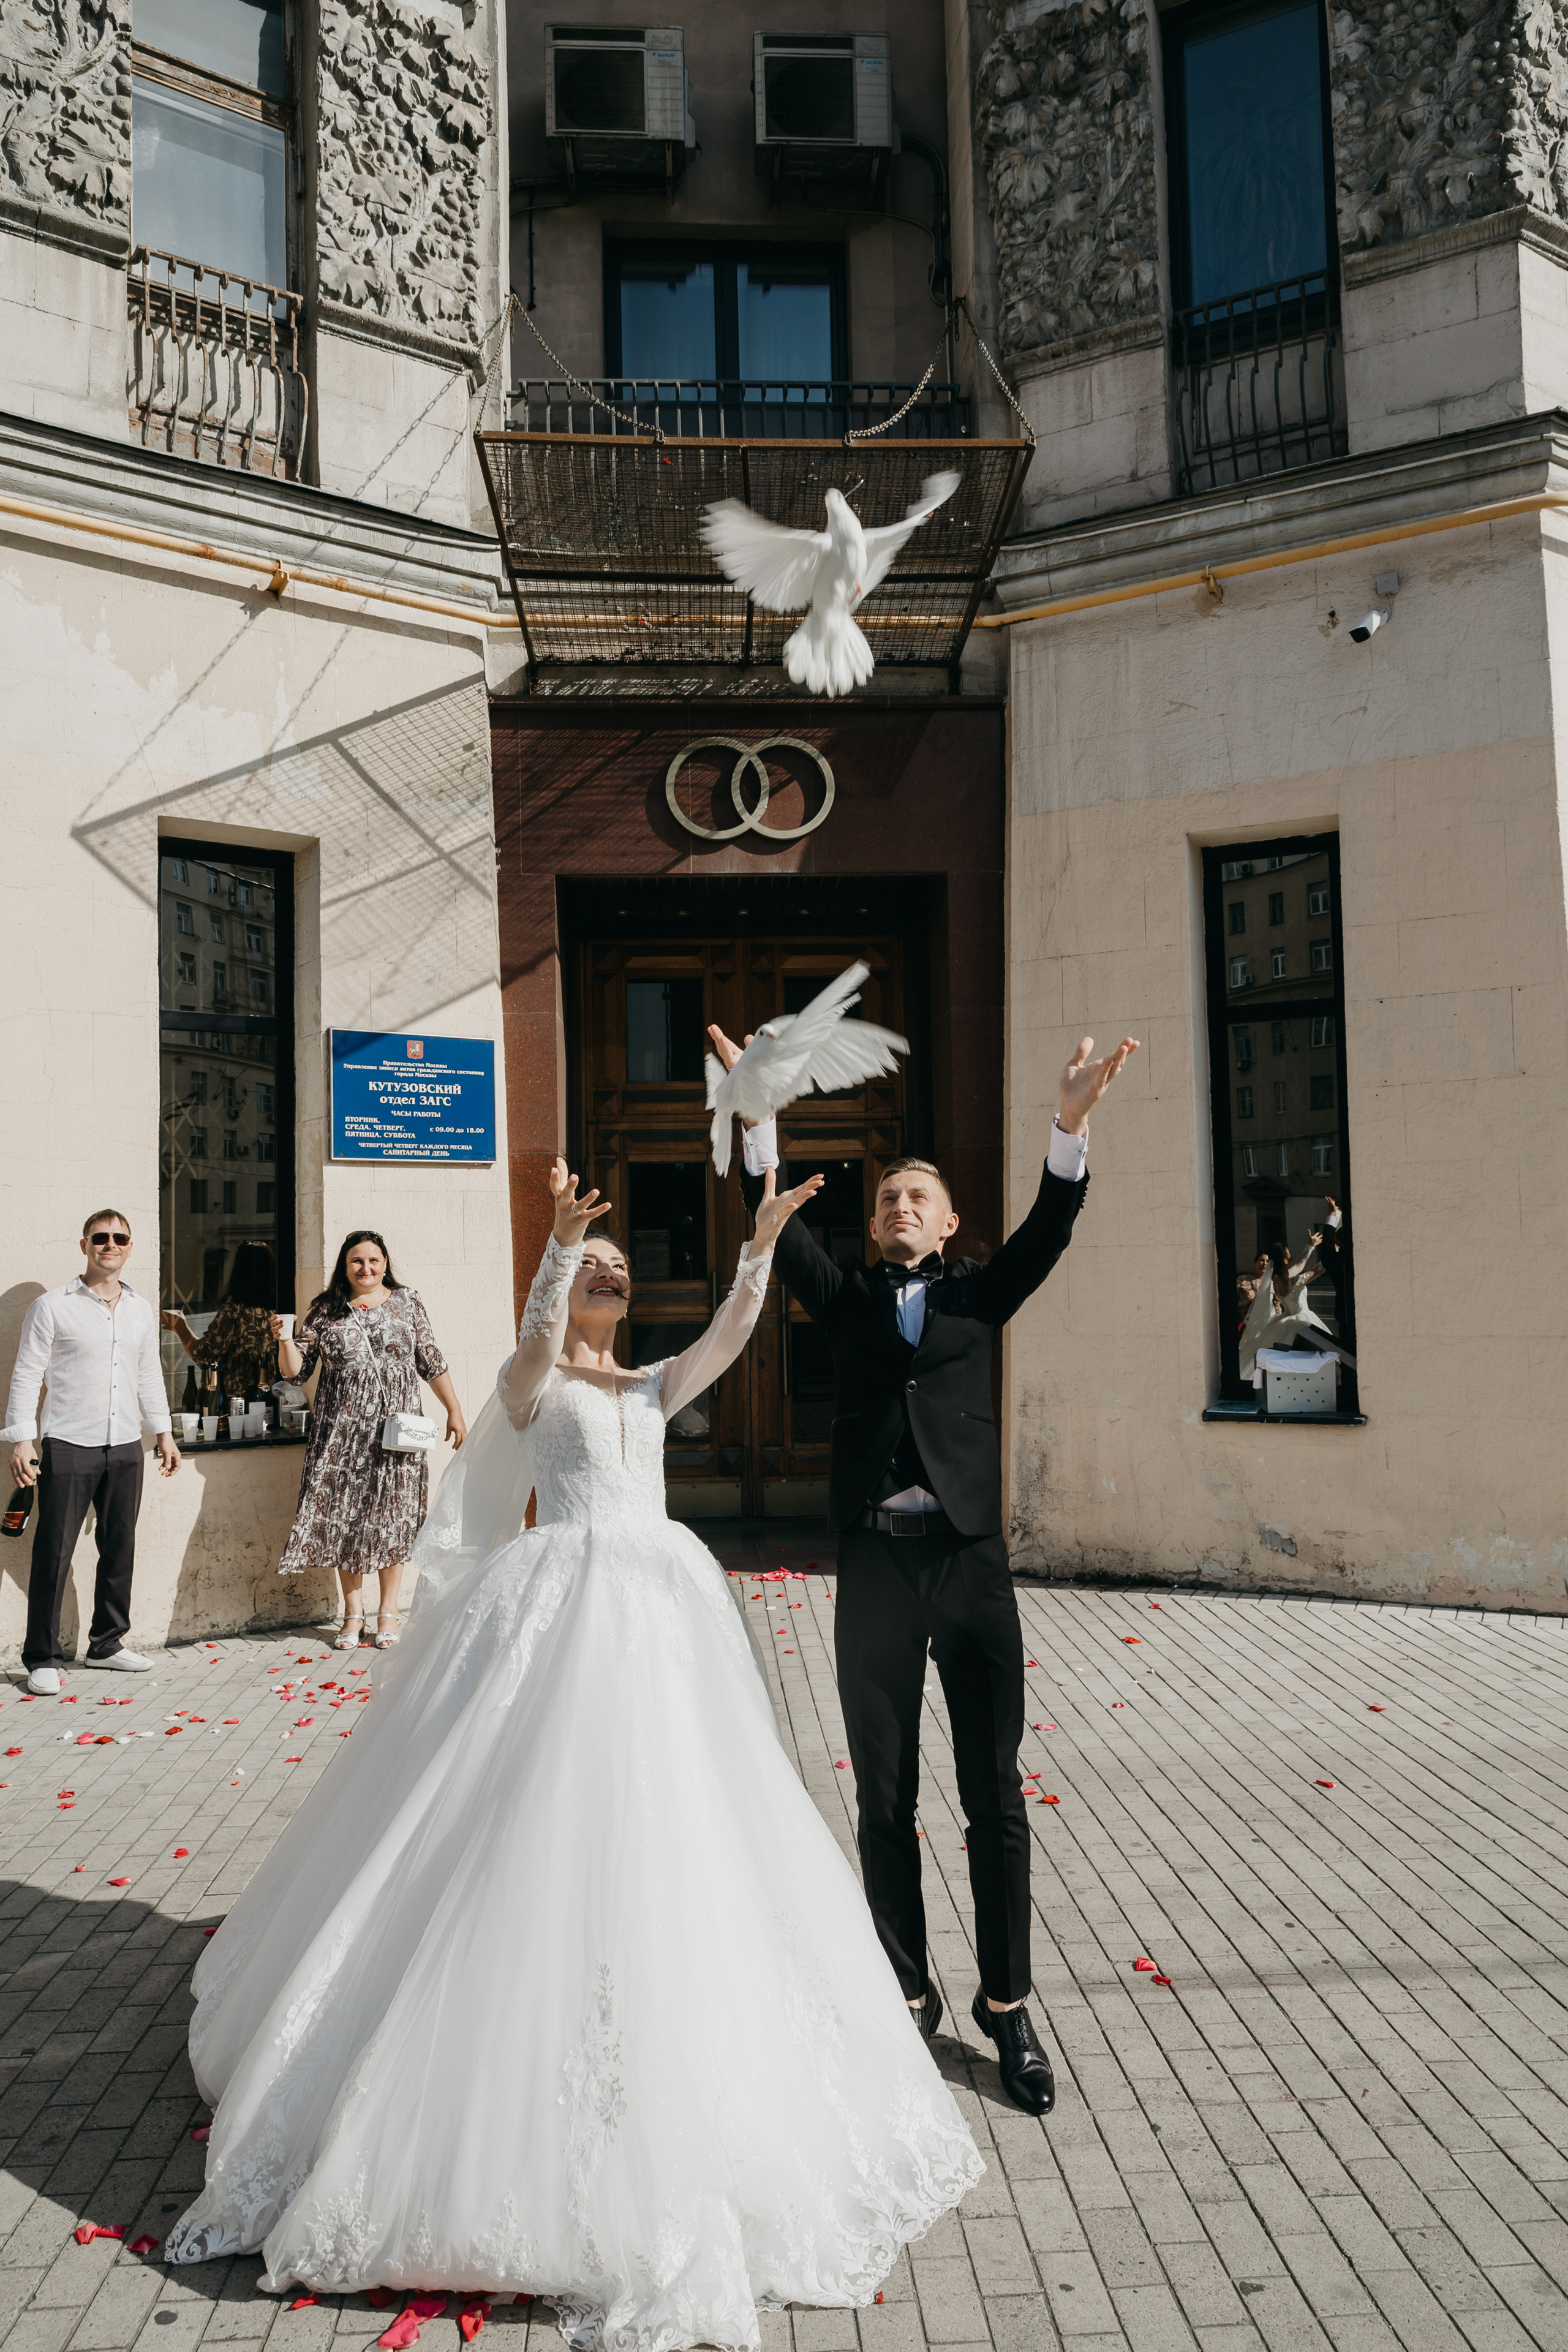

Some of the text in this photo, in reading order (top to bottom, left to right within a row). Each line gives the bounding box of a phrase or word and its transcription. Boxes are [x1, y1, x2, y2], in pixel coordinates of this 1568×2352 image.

[368, 1081, 462, 1095] КУТУЗОВСКИЙ
[379, 1095, 451, 1106] отдел ЗАГС
